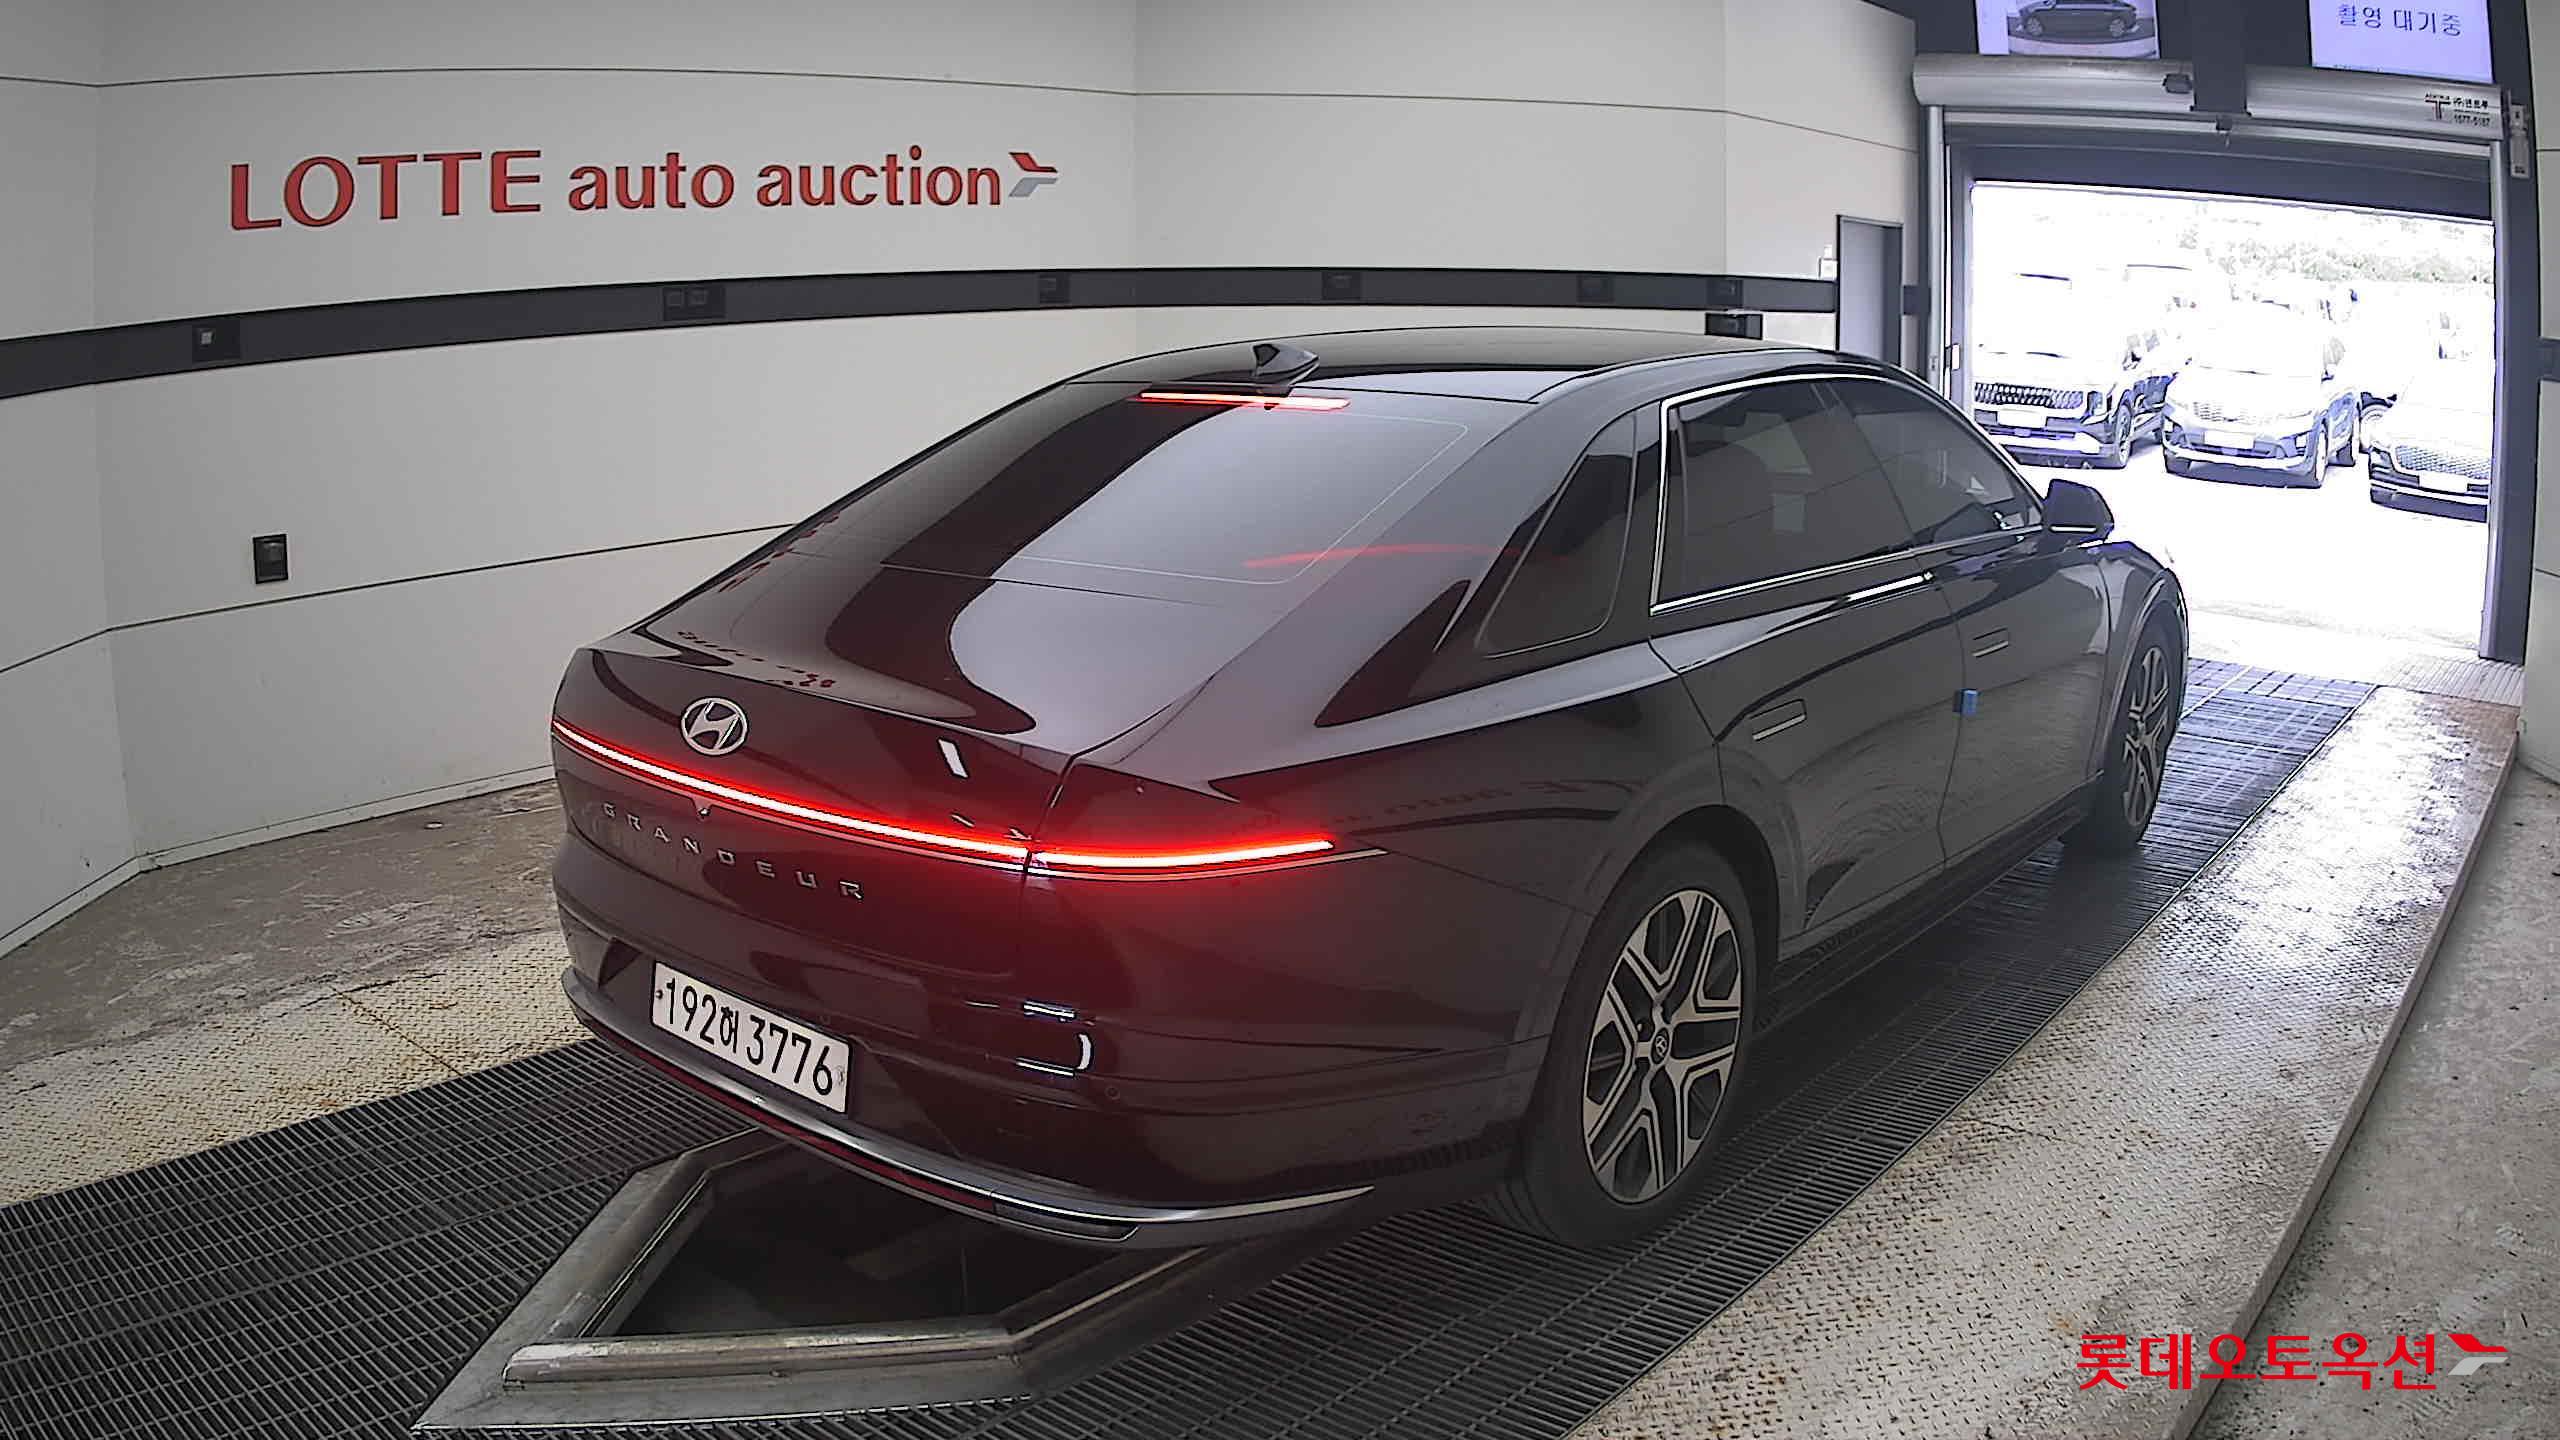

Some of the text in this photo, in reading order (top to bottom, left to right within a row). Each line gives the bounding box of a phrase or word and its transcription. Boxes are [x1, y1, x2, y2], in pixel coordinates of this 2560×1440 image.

[2393, 9, 2461, 37] 대기중
[231, 145, 1001, 230] LOTTE auto auction
[601, 802, 864, 900] GRANDEUR
